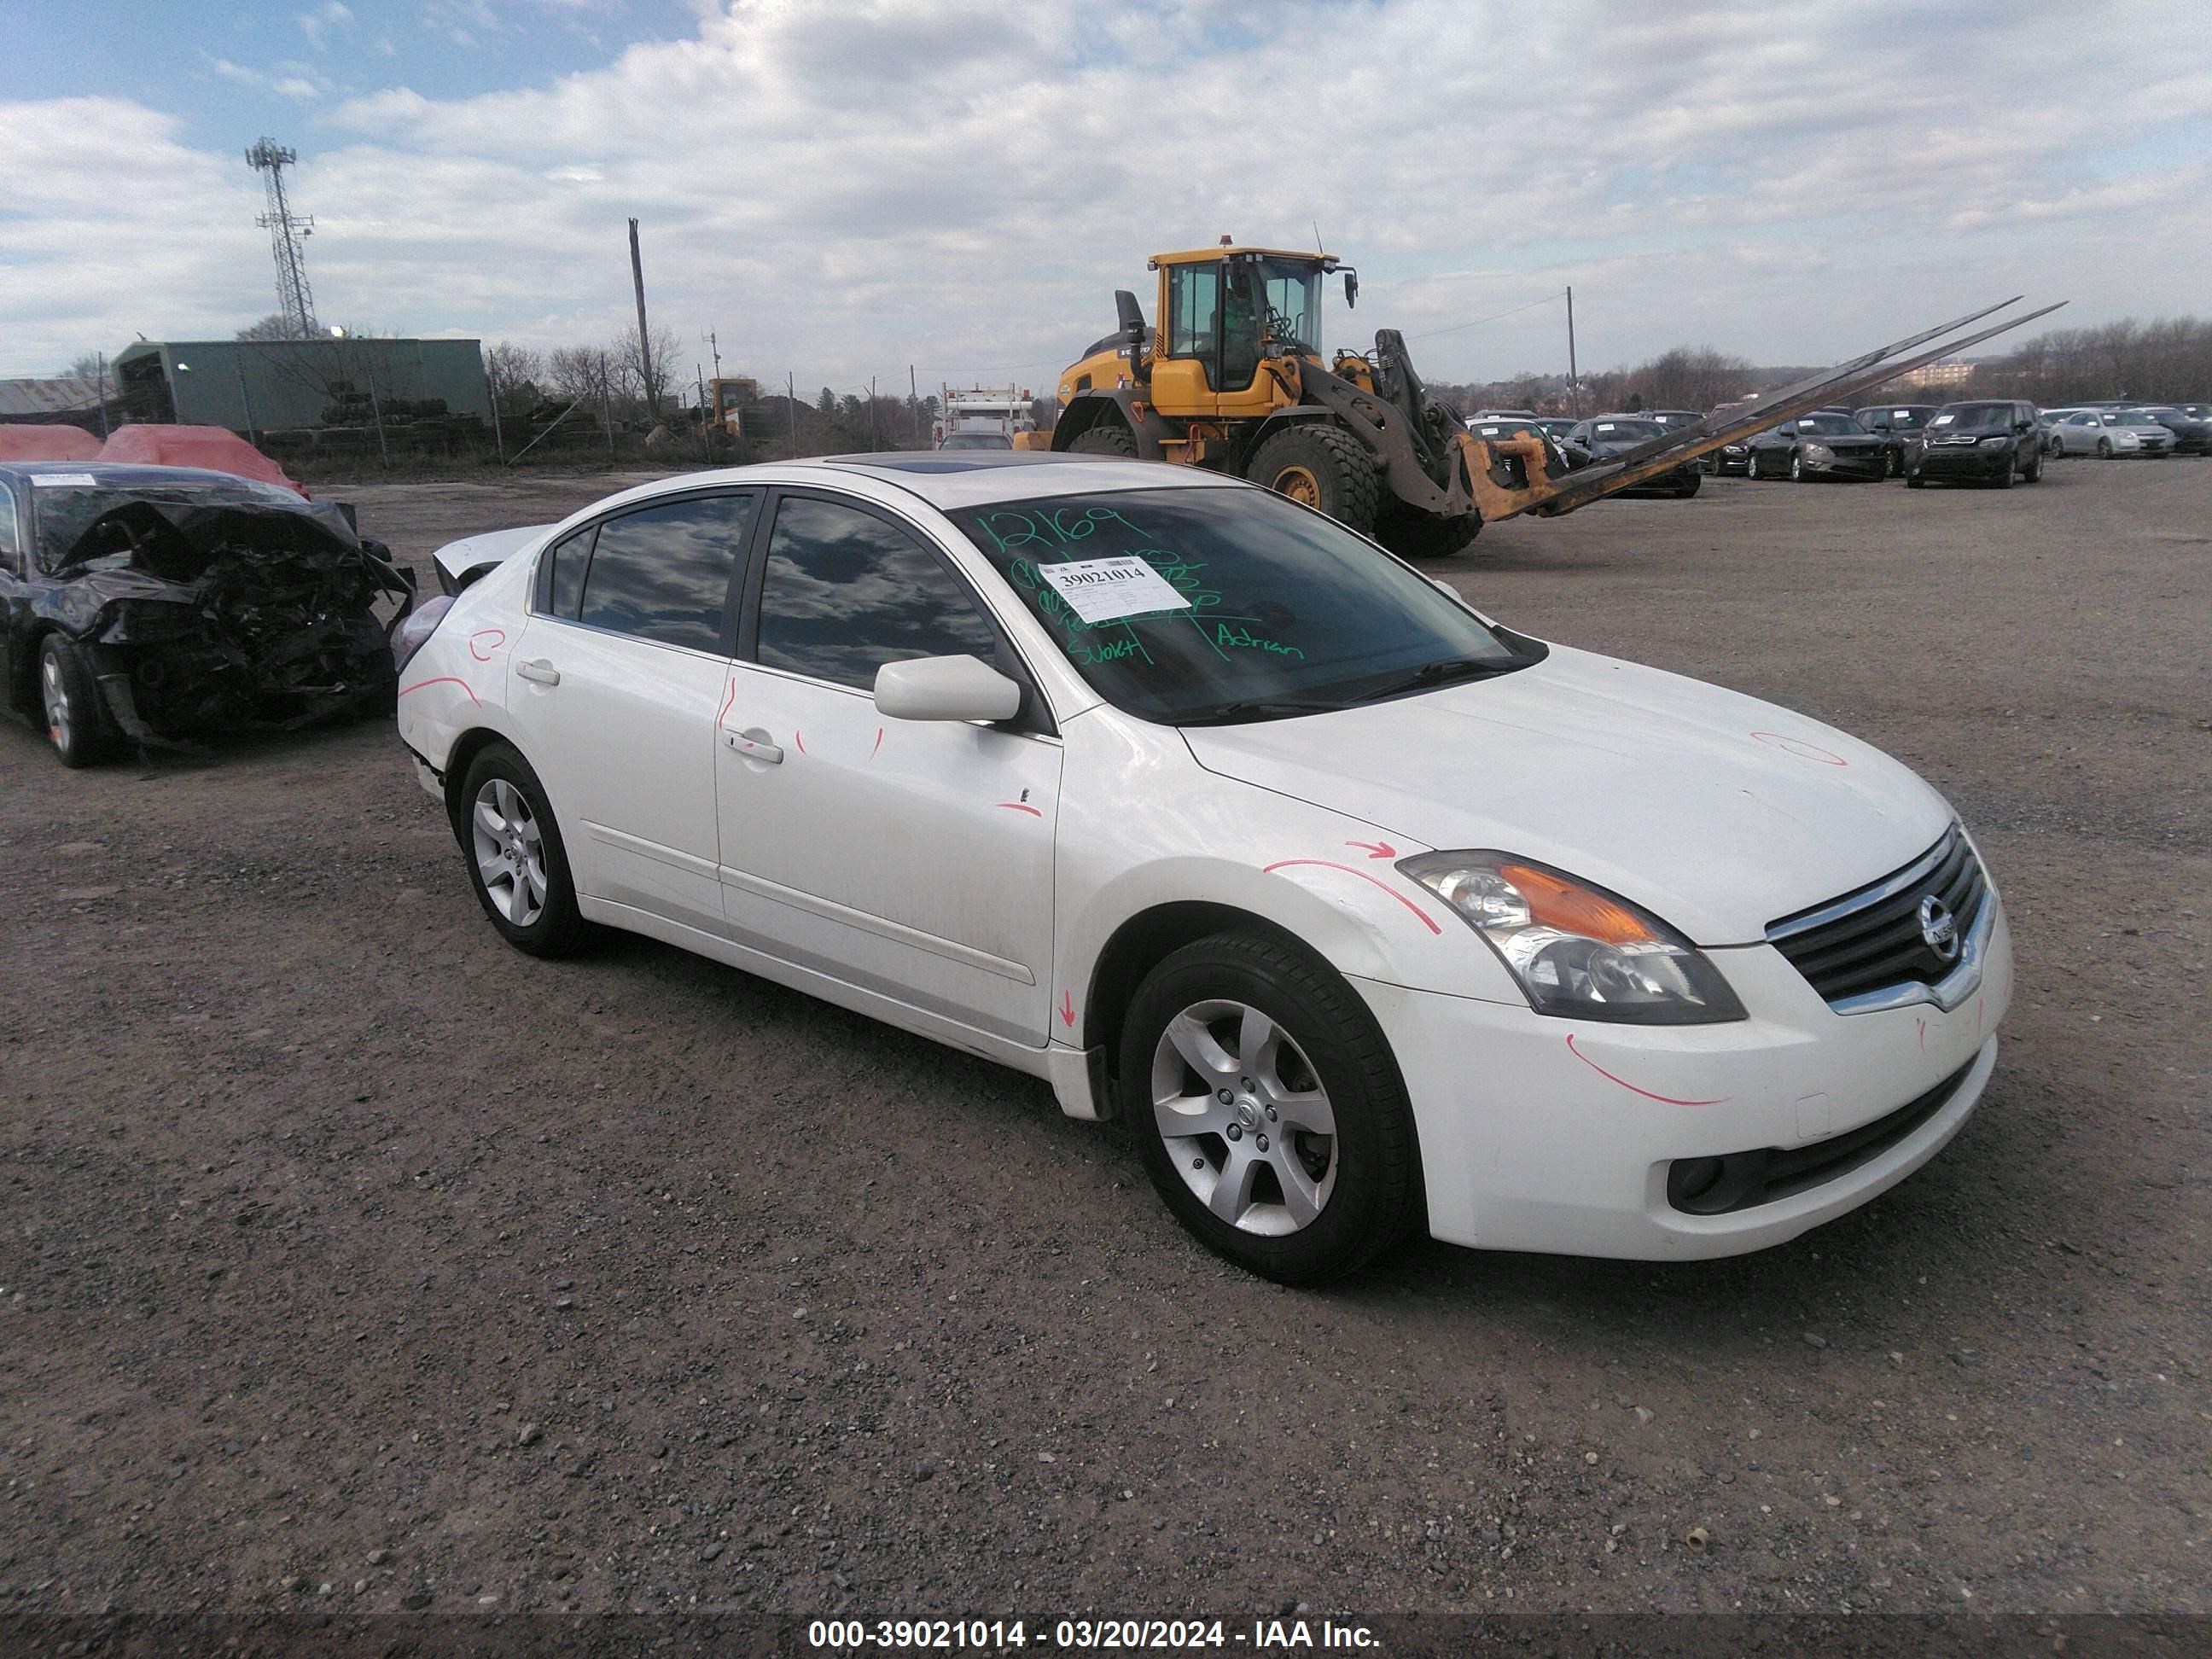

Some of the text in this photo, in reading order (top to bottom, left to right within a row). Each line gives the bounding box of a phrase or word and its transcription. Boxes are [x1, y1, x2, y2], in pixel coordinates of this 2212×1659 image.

[1120, 346, 1150, 356] VOVO
[977, 507, 1152, 553] 12169
[1059, 567, 1145, 587] 39021014
